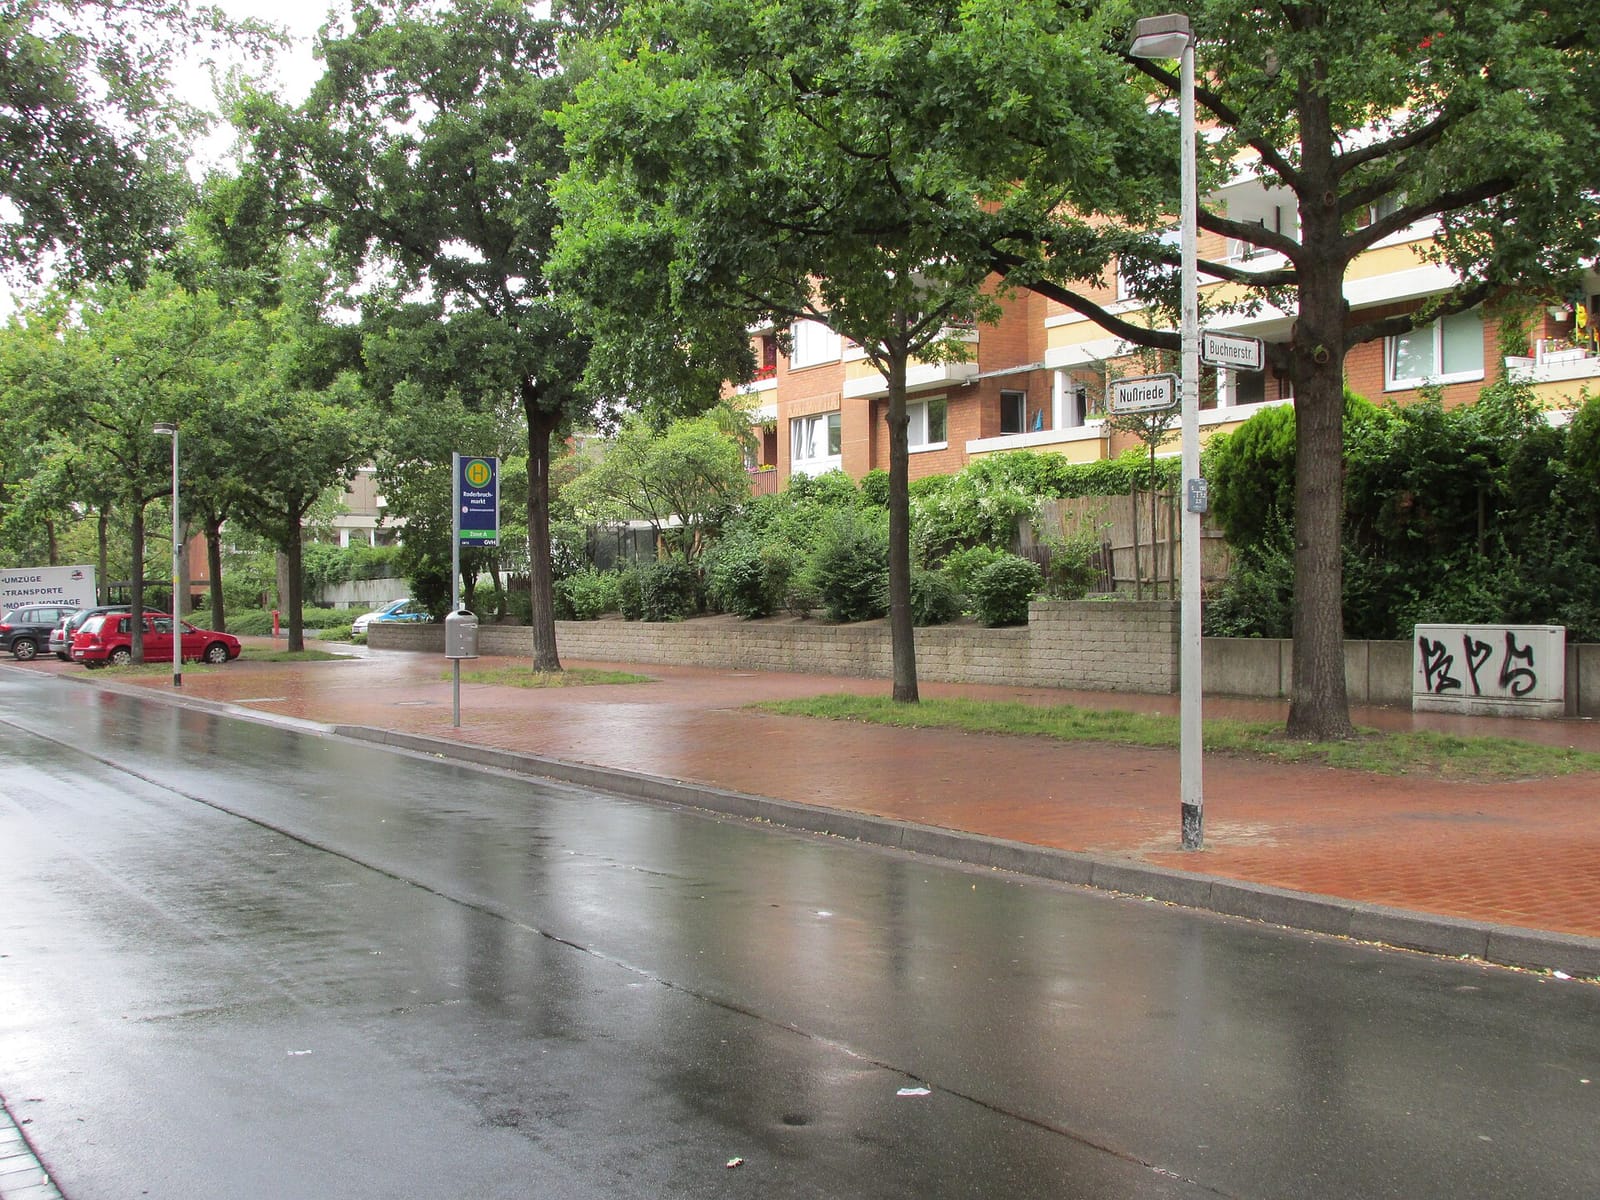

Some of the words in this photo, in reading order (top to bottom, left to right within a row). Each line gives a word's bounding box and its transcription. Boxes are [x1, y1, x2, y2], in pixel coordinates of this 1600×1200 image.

[1209, 339, 1254, 361] Buchnerstr.
[1119, 386, 1164, 403] Nußriede
[473, 464, 484, 481] H
[5, 586, 64, 597] TRANSPORTE
